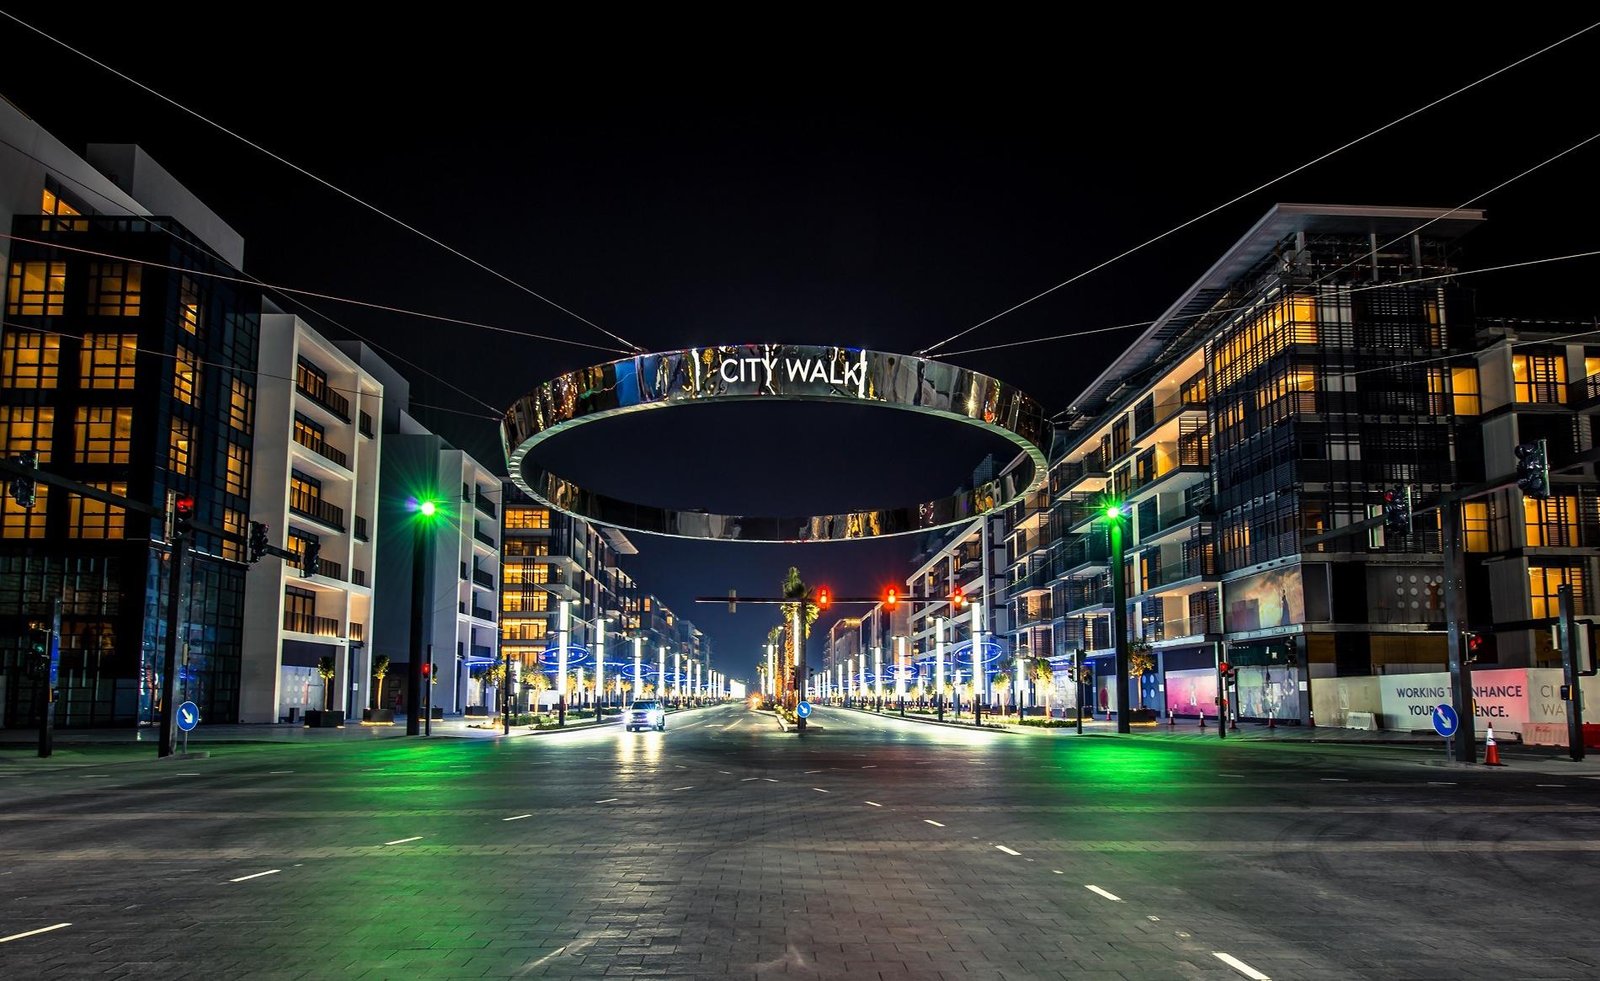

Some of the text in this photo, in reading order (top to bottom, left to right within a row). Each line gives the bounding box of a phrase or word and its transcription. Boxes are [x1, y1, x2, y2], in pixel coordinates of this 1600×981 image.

[720, 358, 862, 386] CITY WALK
[1396, 687, 1445, 698] WORKING
[1473, 686, 1523, 698] NHANCE
[1541, 703, 1565, 716] WA
